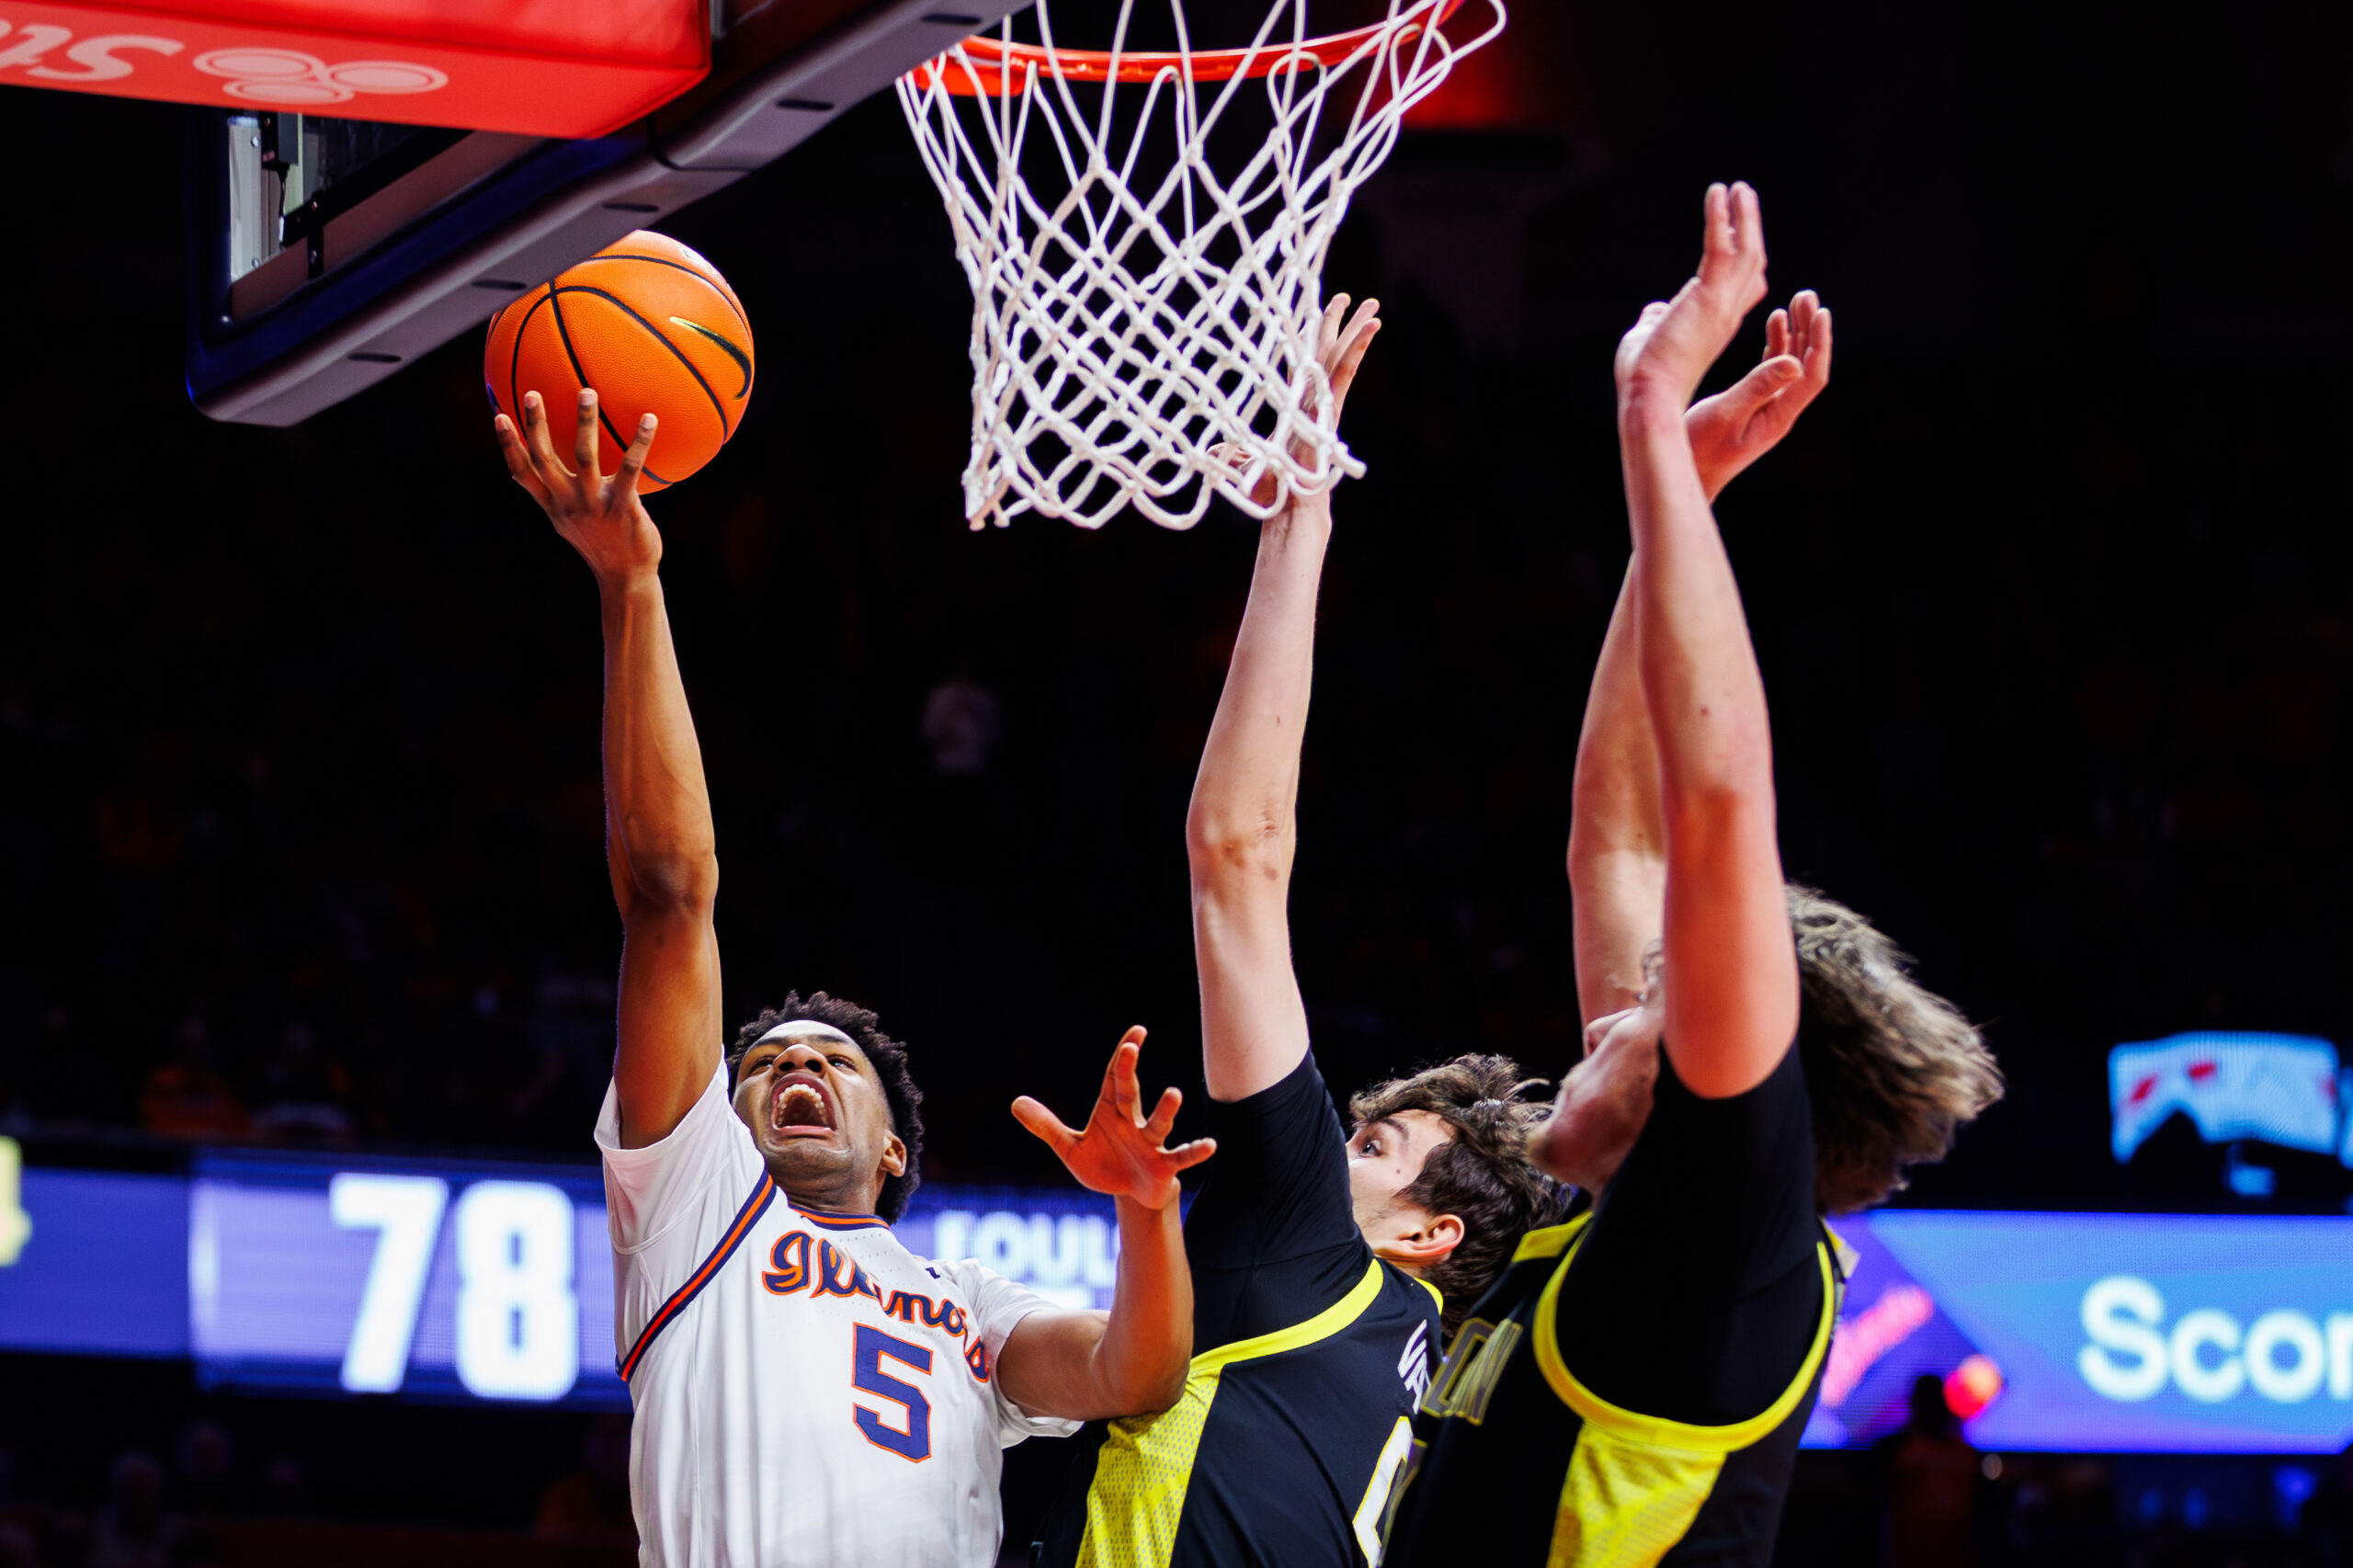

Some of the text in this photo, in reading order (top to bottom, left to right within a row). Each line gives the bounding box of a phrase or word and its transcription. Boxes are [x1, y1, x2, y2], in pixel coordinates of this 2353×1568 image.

[0, 18, 186, 82] St
[330, 1173, 578, 1400] 78
[851, 1322, 933, 1463] 5
